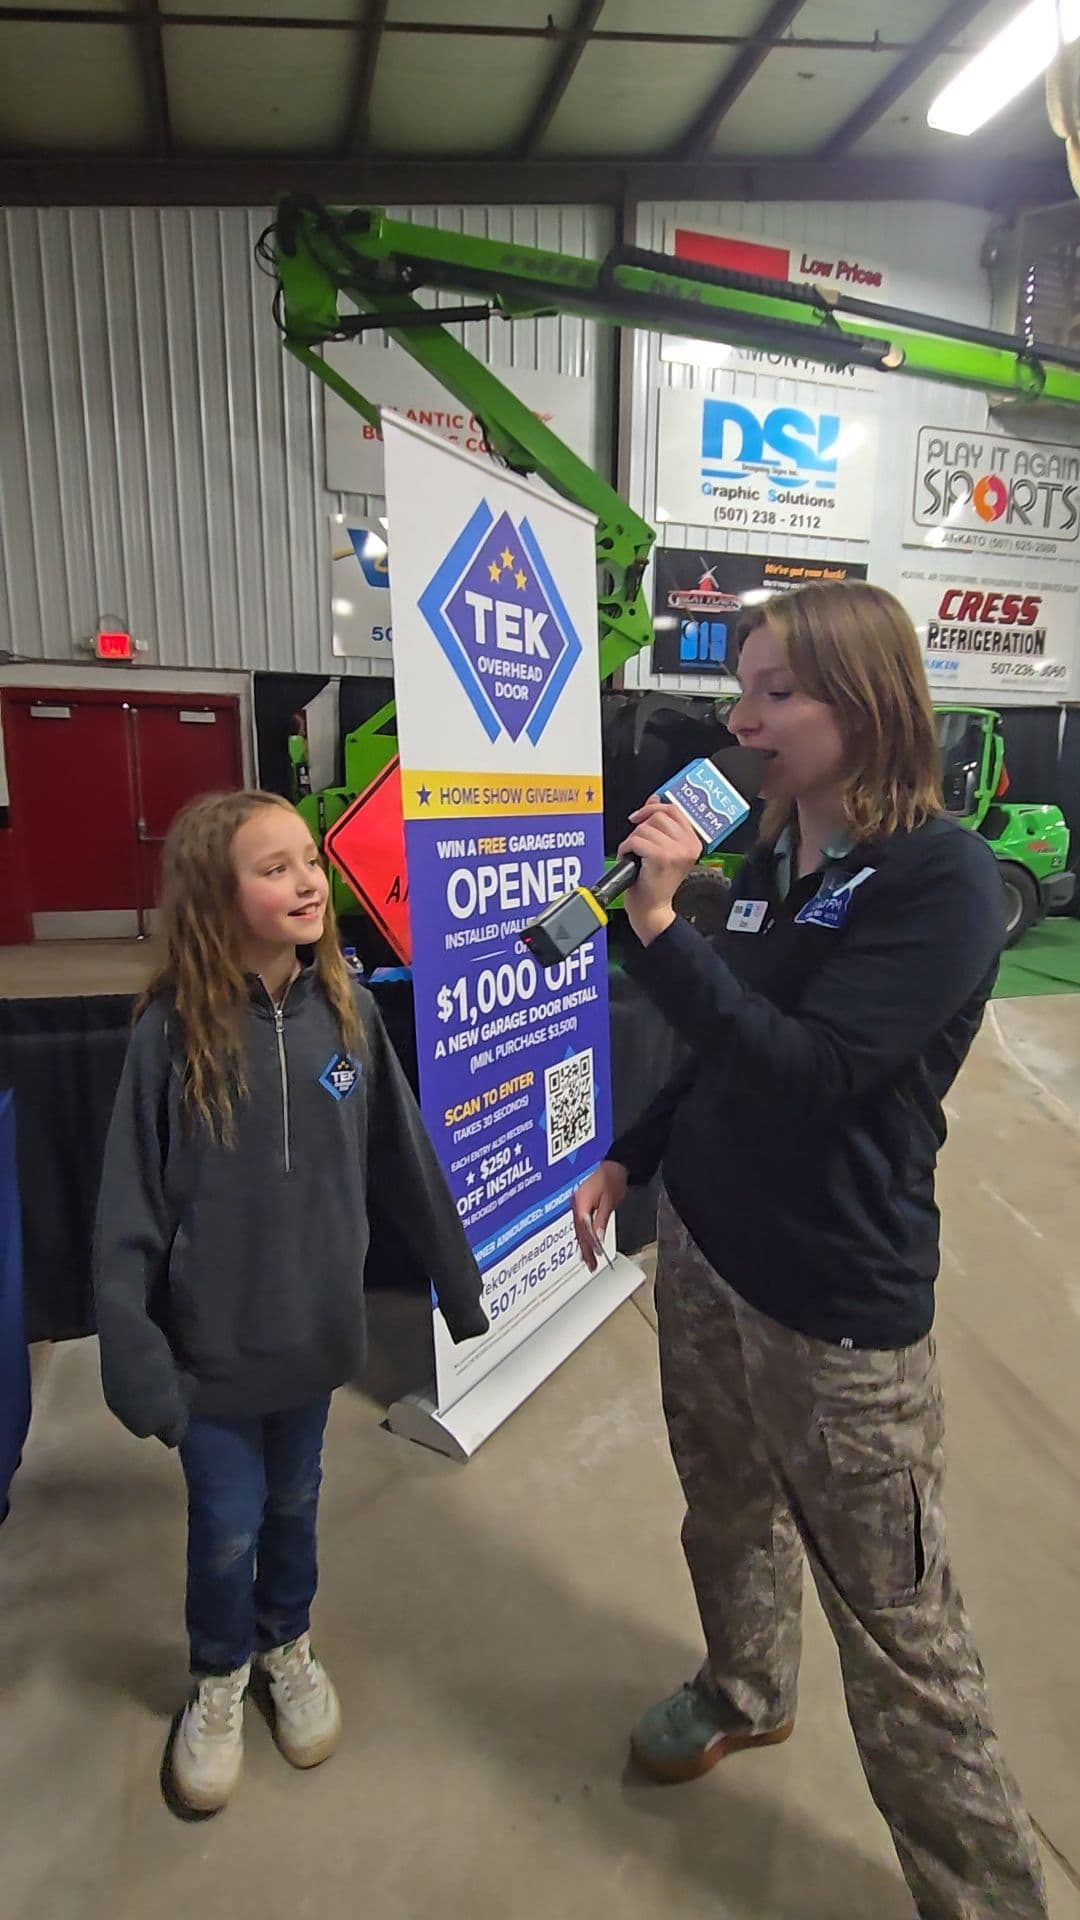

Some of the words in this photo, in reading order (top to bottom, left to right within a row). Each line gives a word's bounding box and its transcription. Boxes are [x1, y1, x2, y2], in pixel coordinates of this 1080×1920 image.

[800, 254, 834, 277] Low
[836, 261, 882, 287] Prices
[928, 438, 983, 469] PLAY
[991, 447, 1010, 472] IT
[1014, 451, 1080, 481] AGAIN
[702, 482, 760, 501] Graphic
[768, 489, 836, 508] Solutions
[923, 467, 1079, 530] SPORTS
[714, 506, 748, 525] (507)
[752, 510, 776, 525] 238
[790, 514, 821, 528] 2112
[465, 590, 550, 659] TEK
[938, 588, 1043, 626] CRESS
[926, 622, 1048, 655] REFRIGERATION
[477, 656, 543, 682] OVERHEAD
[495, 682, 529, 700] DOOR
[440, 786, 480, 805] HOME
[483, 787, 522, 804] SHOW
[526, 787, 580, 804] GIVEAWAY
[681, 783, 708, 813] 106.5
[705, 811, 724, 831] FM
[696, 769, 738, 816] LAKES
[437, 839, 465, 859] WIN
[467, 838, 477, 857] A
[478, 836, 506, 855] FREE
[509, 832, 555, 852] GARAGE
[557, 831, 585, 847] DOOR
[446, 856, 581, 920] OPENER
[445, 923, 499, 949] INSTALLED
[437, 958, 537, 1024] $1,000
[544, 942, 594, 991] OFF
[435, 1040, 447, 1060] A
[448, 1027, 480, 1054] NEW
[481, 1010, 528, 1041] GARAGE
[529, 999, 561, 1023] DOOR
[562, 985, 598, 1011] INSTALL
[470, 1049, 494, 1075] (MIN.
[495, 1028, 547, 1060] PURCHASE
[548, 1016, 577, 1040] $3,500)
[331, 1070, 356, 1083] TEK
[444, 1096, 480, 1127] SCAN
[482, 1088, 498, 1108] TO
[499, 1071, 534, 1100] ENTER
[453, 1120, 482, 1144] (TAKES
[483, 1114, 493, 1129] 30
[493, 1094, 529, 1122] SECONDS)
[451, 1154, 470, 1173] EACH
[471, 1144, 491, 1162] ENTRY
[491, 1134, 507, 1151] ALSO
[480, 1147, 511, 1181] $250
[456, 1186, 484, 1217] OFF
[487, 1156, 533, 1200] INSTALL
[490, 1237, 580, 1321] 507-766-5827
